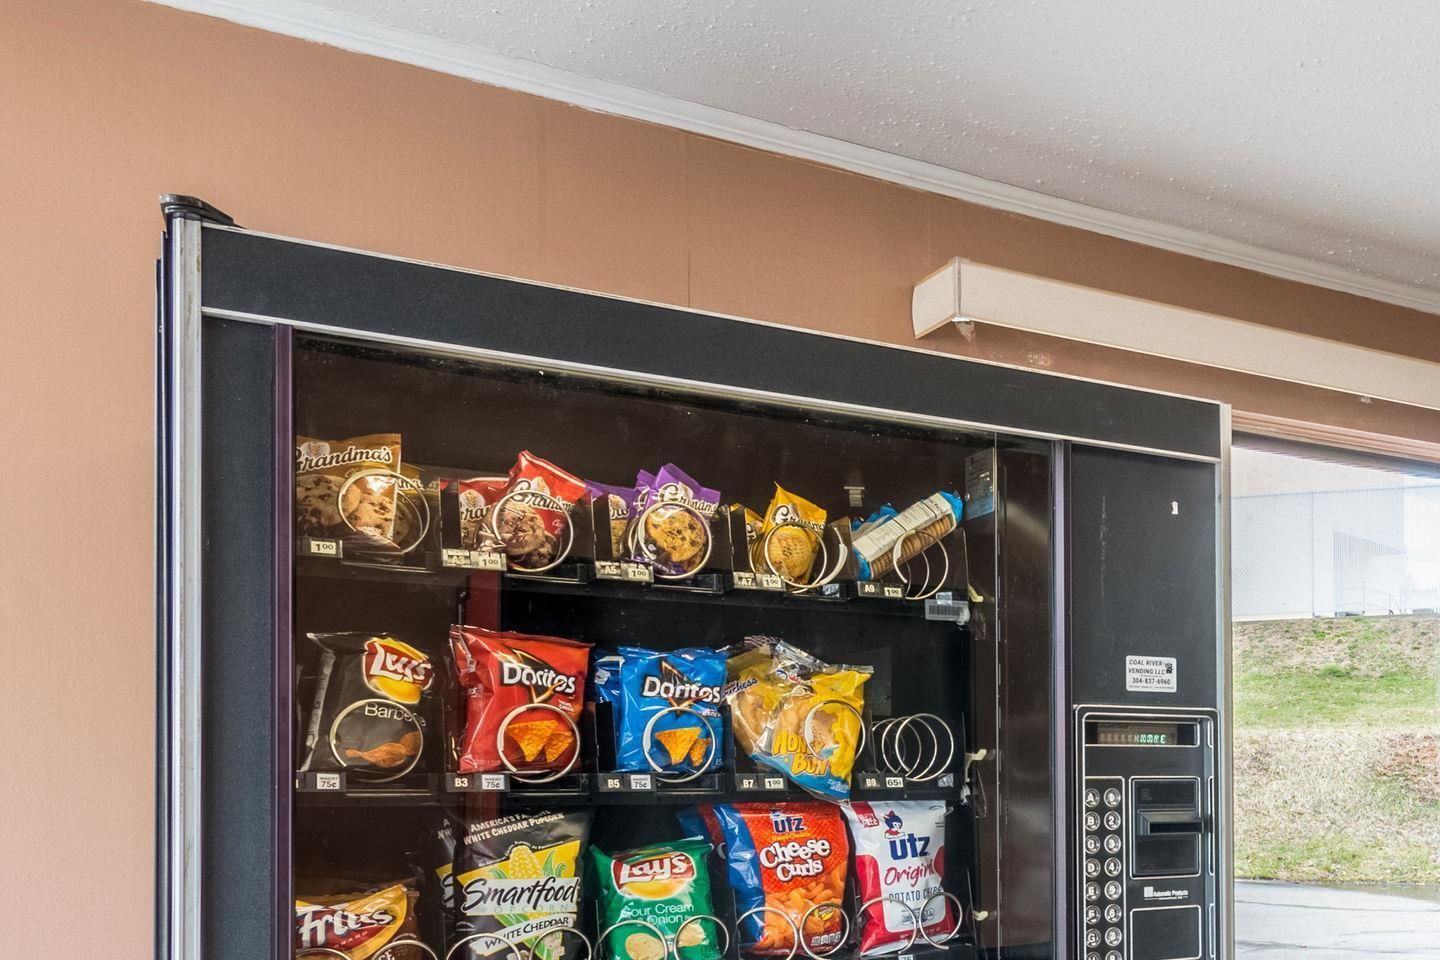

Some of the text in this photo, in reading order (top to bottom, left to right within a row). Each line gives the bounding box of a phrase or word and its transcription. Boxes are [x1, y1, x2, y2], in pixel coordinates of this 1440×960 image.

[1171, 501, 1179, 515] 1
[451, 555, 464, 564] A3
[604, 565, 617, 575] A5
[741, 578, 752, 587] A7
[864, 584, 875, 593] A9
[502, 661, 577, 694] Doritos
[642, 675, 721, 703] Doritos
[454, 777, 468, 788] B3
[607, 779, 620, 788] B5
[742, 779, 754, 787] B7
[866, 778, 877, 787] B9
[1087, 792, 1095, 801] A
[1088, 816, 1095, 825] B
[1108, 816, 1115, 825] 2
[463, 832, 491, 846] WHITE
[491, 820, 529, 836] CHEDDAR
[759, 838, 831, 869] Cheese
[619, 854, 692, 885] Lay's
[776, 858, 823, 882] Curls
[461, 876, 580, 912] Smartfood
[655, 903, 695, 914] Cream
[522, 916, 569, 934] CHEDDAR
